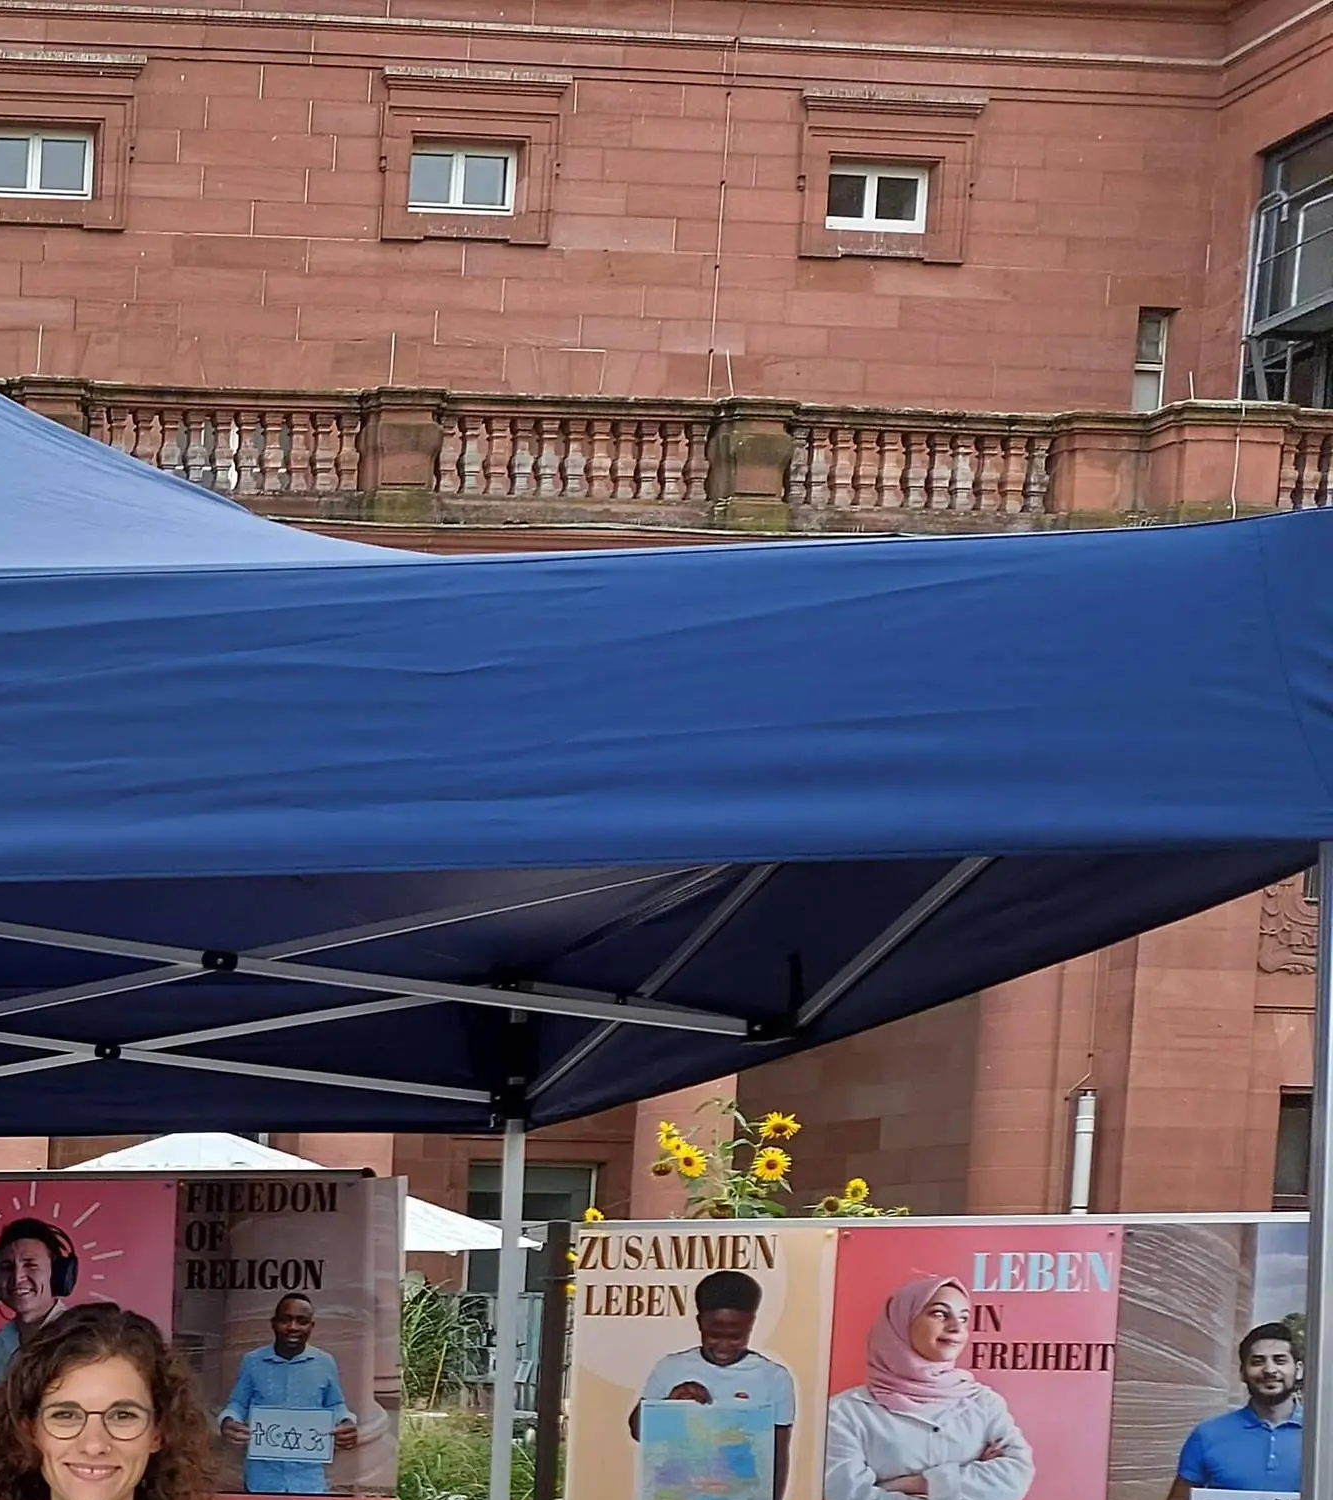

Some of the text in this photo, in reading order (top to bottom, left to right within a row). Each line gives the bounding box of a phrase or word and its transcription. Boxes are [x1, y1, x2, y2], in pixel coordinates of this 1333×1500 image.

[187, 1182, 339, 1214] FREEDOM
[186, 1220, 228, 1252] OF
[578, 1234, 777, 1271] ZUSAMMEN
[186, 1258, 325, 1290] RELIGON
[973, 1252, 1112, 1293] LEBEN
[584, 1284, 689, 1318] LEBEN
[972, 1303, 1001, 1333] IN
[971, 1342, 1117, 1373] FREIHEIT
